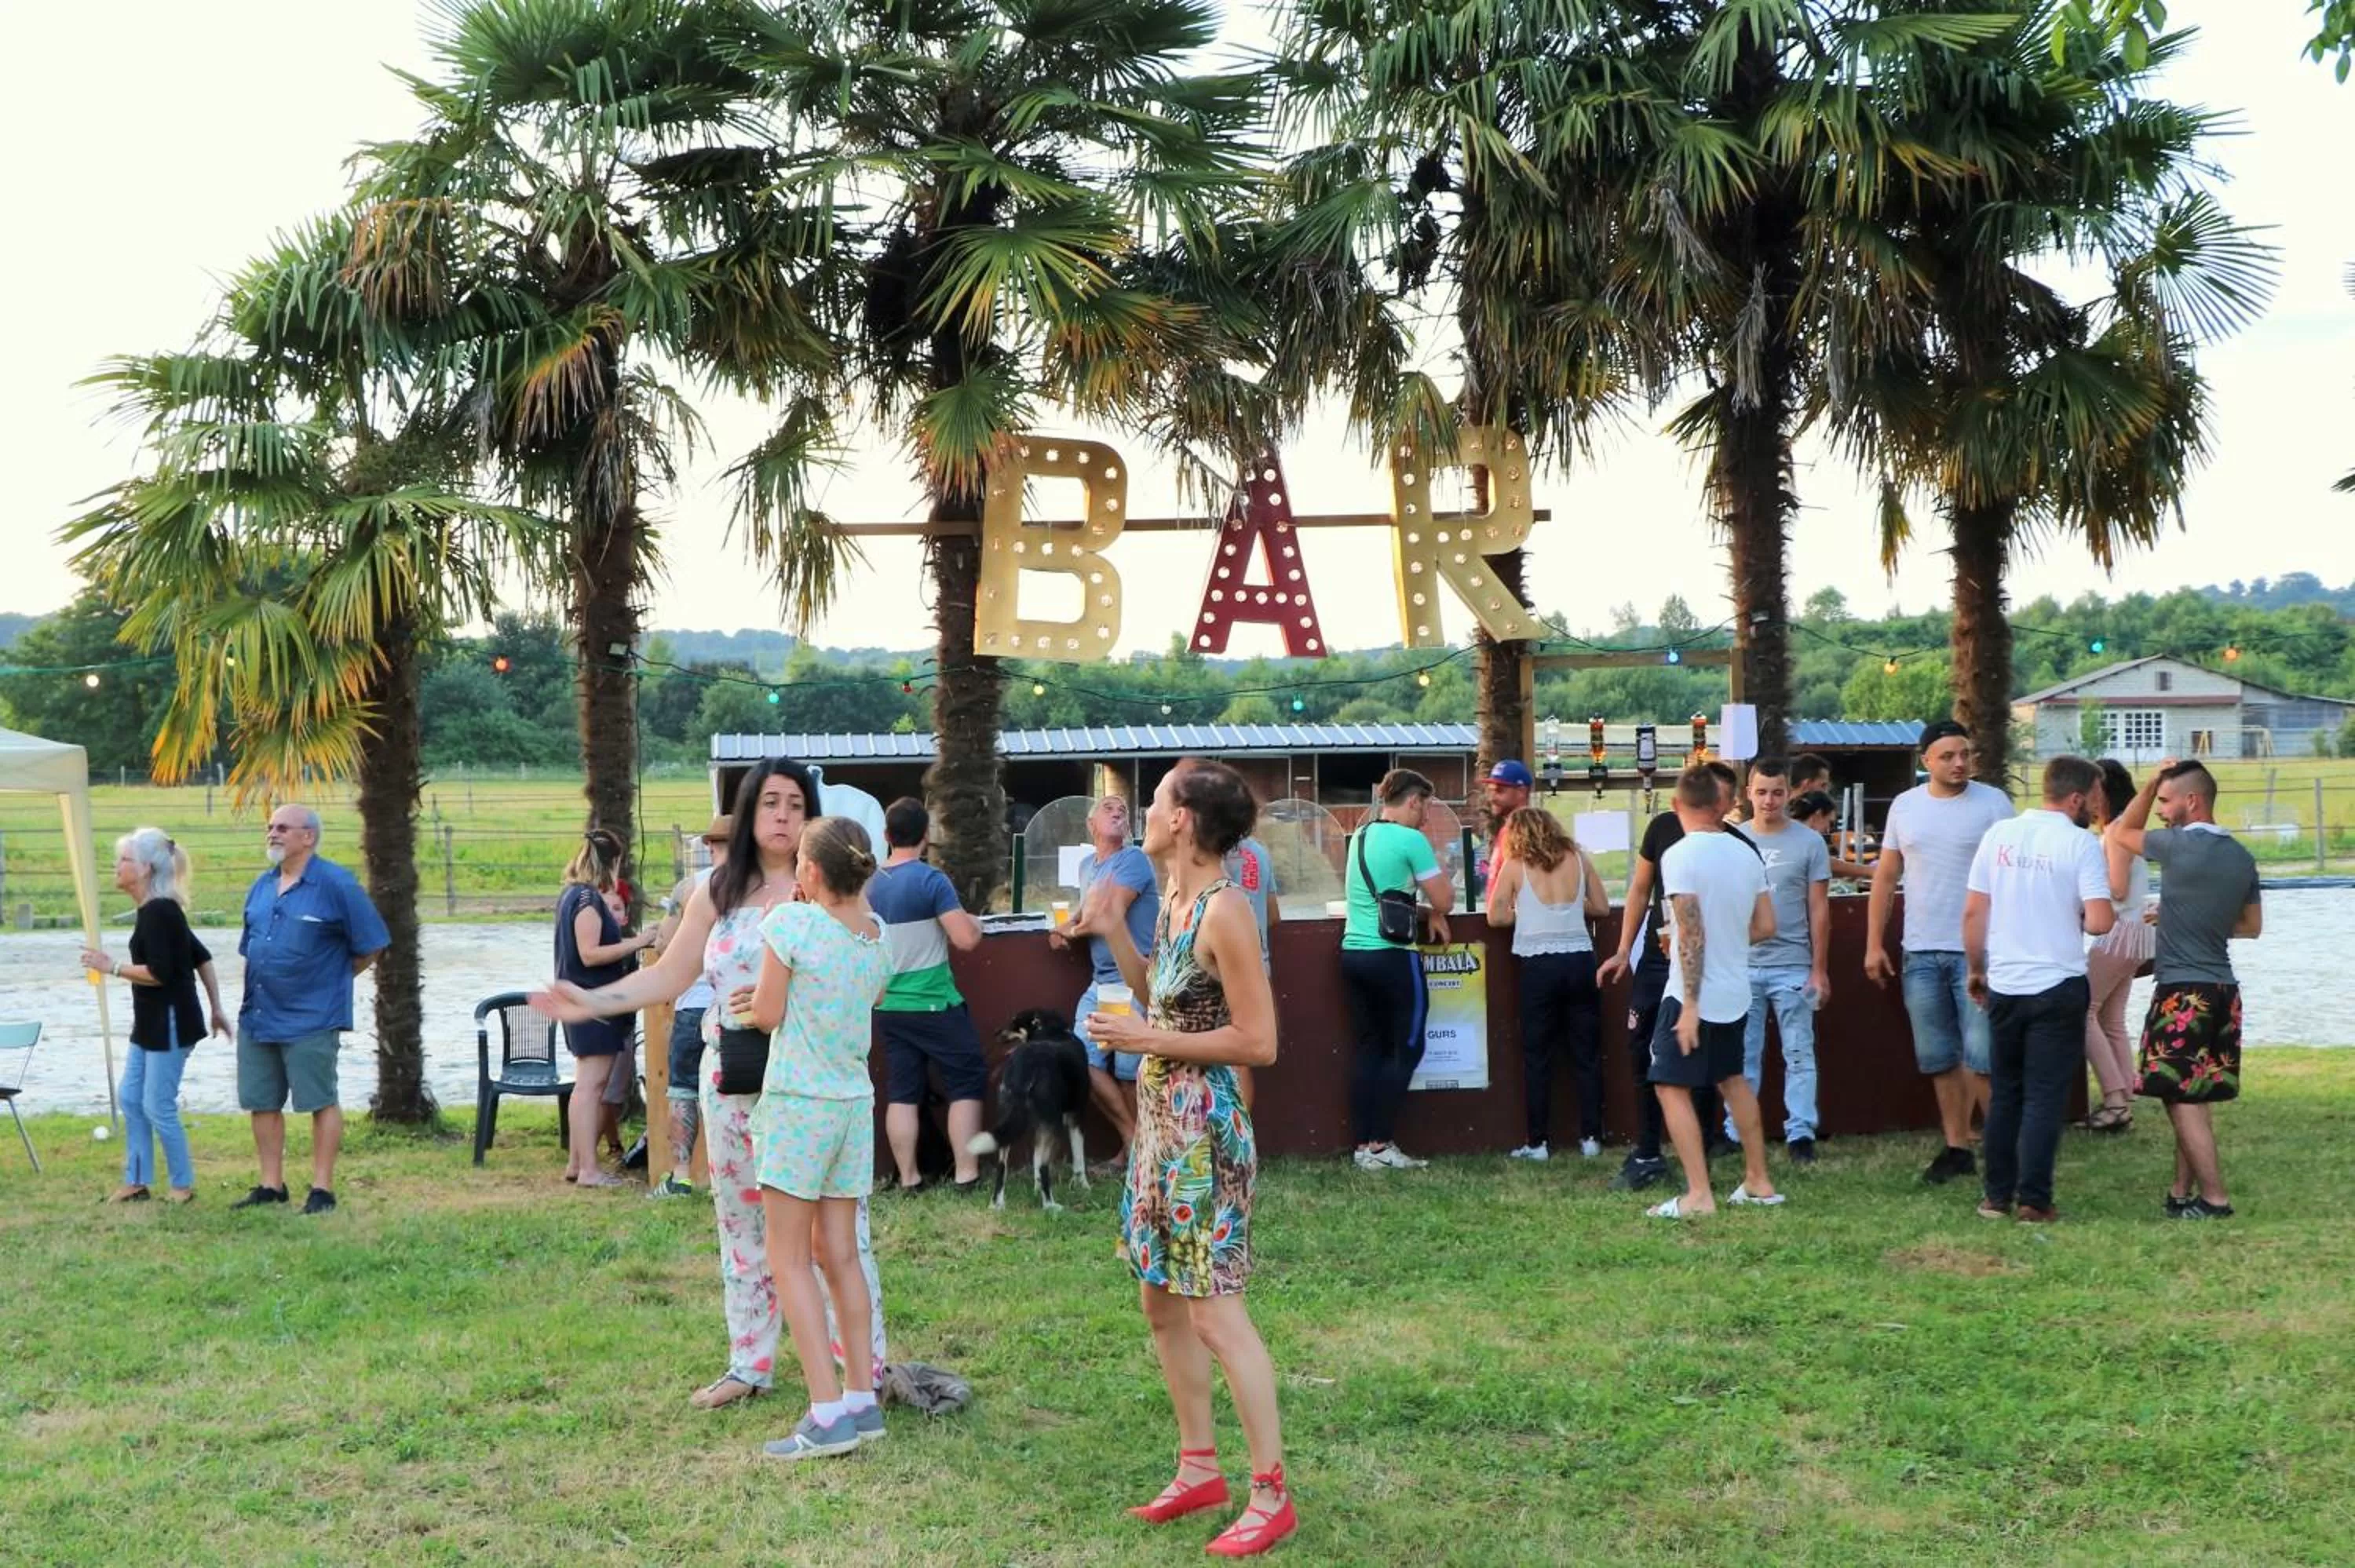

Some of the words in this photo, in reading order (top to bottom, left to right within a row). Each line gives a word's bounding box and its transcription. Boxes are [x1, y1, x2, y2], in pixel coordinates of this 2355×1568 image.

[973, 425, 1545, 660] BAR
[1422, 951, 1478, 973] MBALA
[1426, 1030, 1457, 1040] GURS
